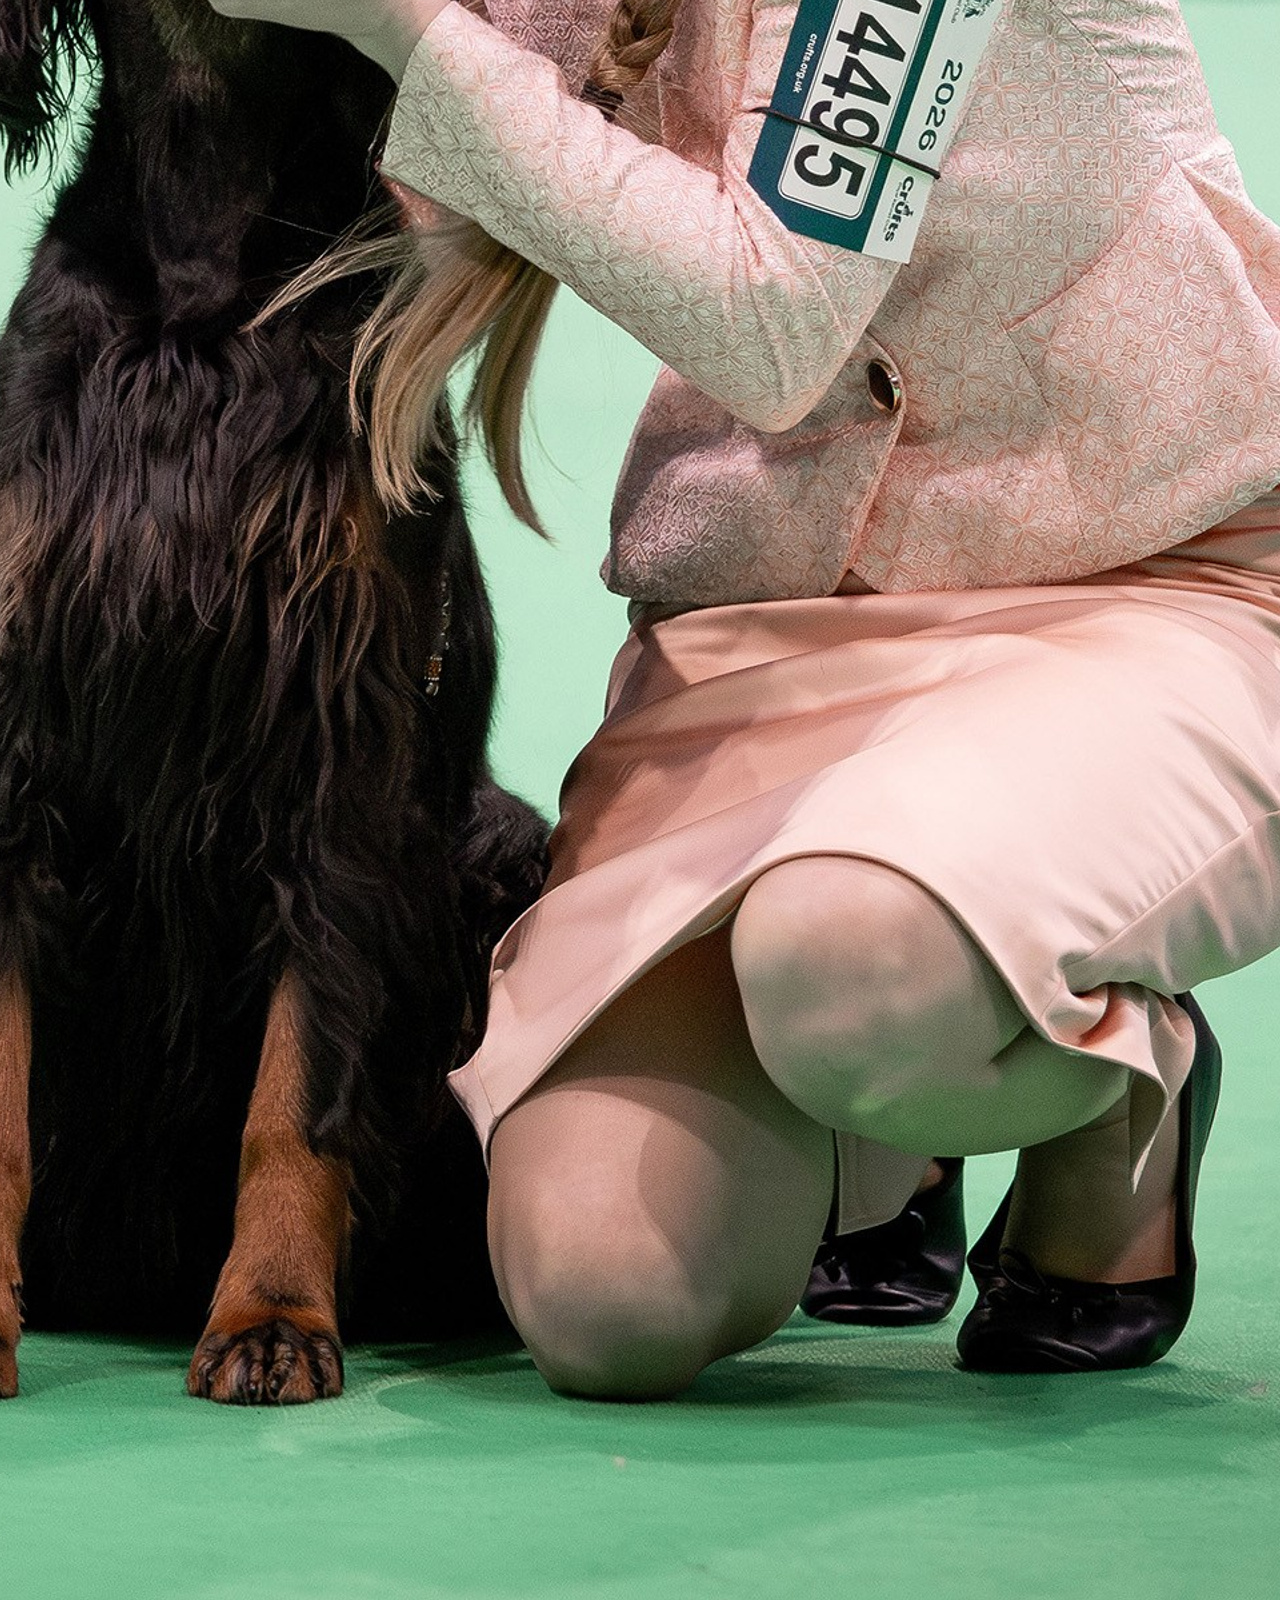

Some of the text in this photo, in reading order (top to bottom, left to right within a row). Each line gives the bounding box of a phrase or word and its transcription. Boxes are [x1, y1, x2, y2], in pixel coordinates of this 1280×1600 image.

[793, 33, 817, 94] crufts.org.uk
[918, 58, 963, 152] 2026
[884, 176, 914, 242] Crufts
